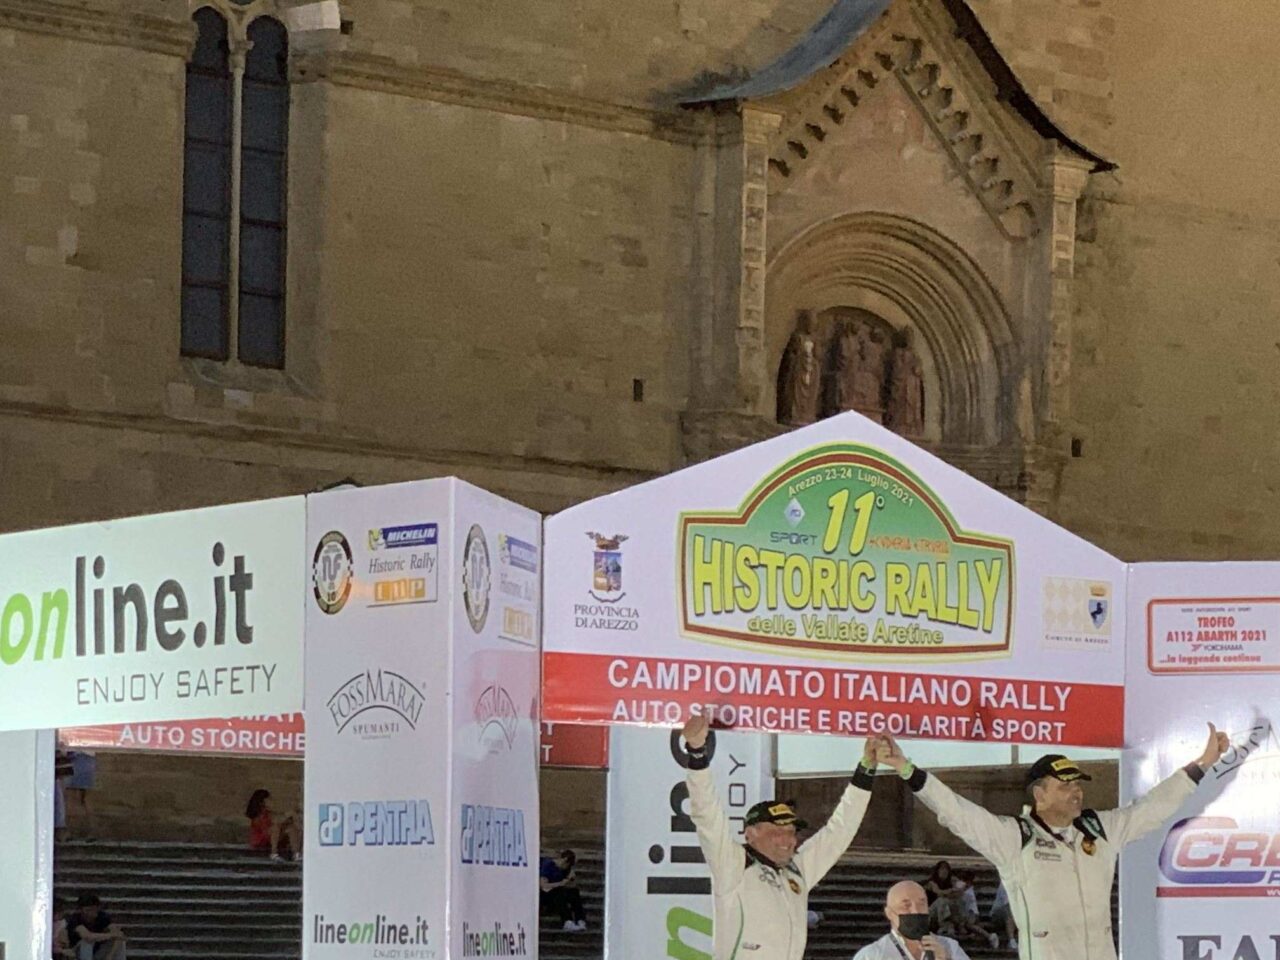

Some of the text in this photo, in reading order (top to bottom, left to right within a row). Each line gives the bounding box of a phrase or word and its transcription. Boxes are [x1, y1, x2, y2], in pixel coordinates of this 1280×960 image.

[788, 472, 823, 498] Arezzo
[858, 470, 889, 490] Luglio
[387, 528, 436, 542] MICHELIN
[770, 531, 818, 547] SPORT
[367, 552, 436, 574] Historic Rally
[693, 534, 1004, 634] HISTORIC RALLY
[573, 604, 640, 618] PROVINCIA
[1197, 616, 1235, 628] TROFEO
[590, 617, 639, 631] AREZZO
[747, 613, 944, 645] delle Vallate Aretine
[1166, 630, 1267, 642] A112 ABARTH 2021
[76, 663, 277, 705] ENJOY SAFETY
[833, 673, 972, 706] ITALIANO
[979, 681, 1072, 712] RALLY
[612, 699, 1067, 742] AUTO STORICHE E REGOLARITÀ SPORT
[119, 724, 185, 746] AUTO
[314, 914, 429, 945] lineonline.it
[462, 921, 527, 957] lineonline.it
